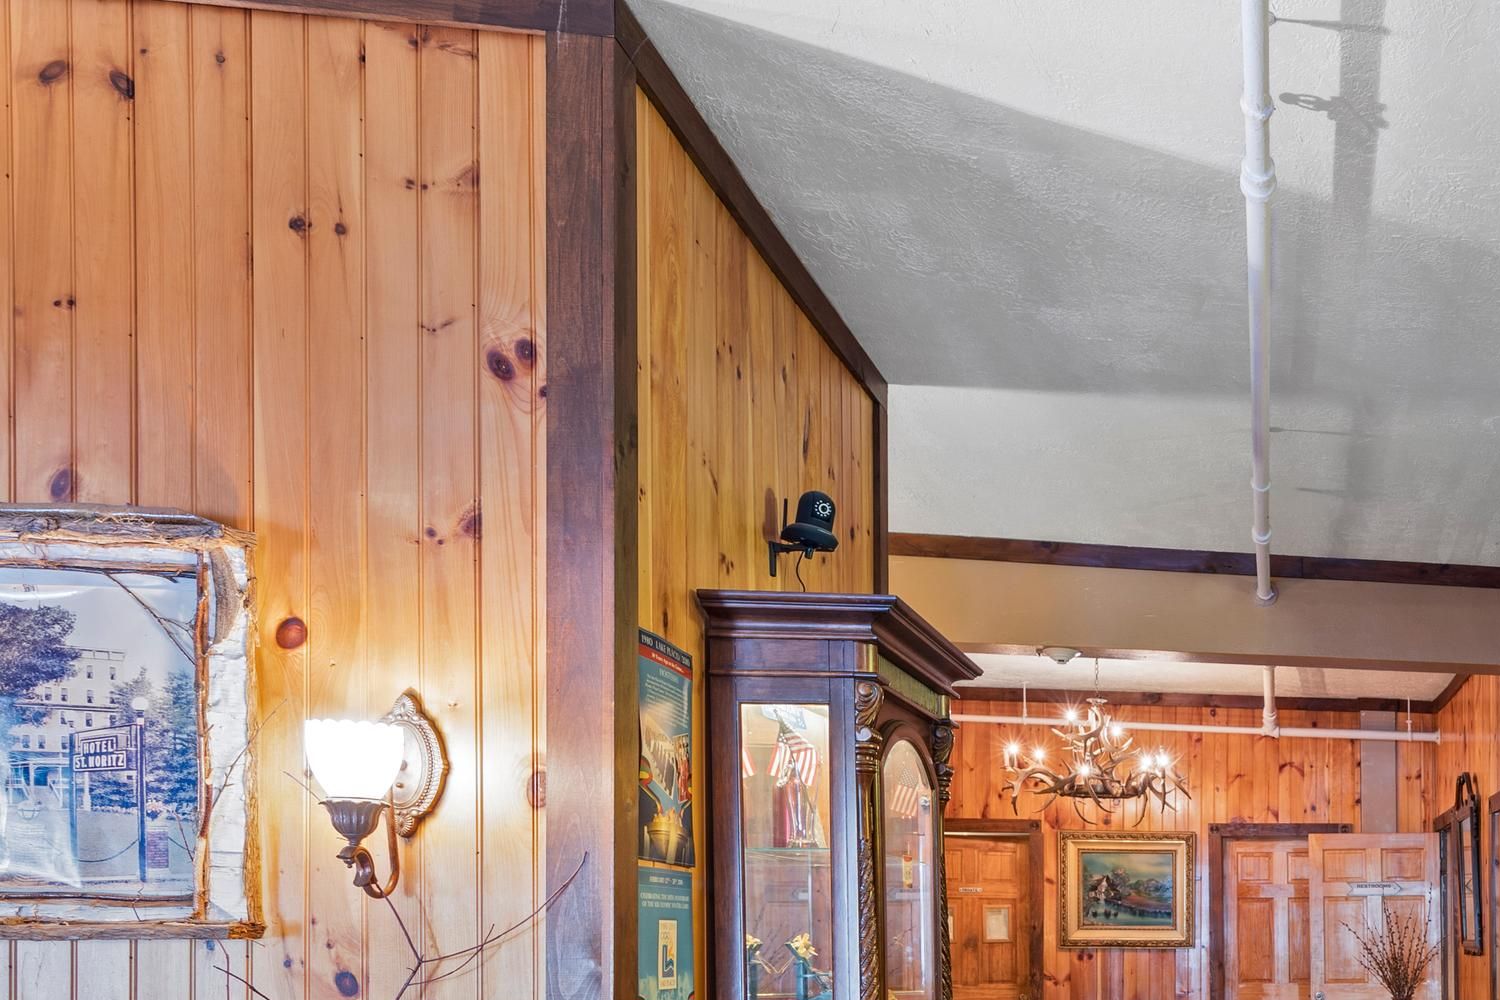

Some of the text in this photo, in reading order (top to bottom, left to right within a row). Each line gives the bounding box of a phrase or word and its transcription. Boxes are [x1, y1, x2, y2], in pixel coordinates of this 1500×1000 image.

[83, 740, 114, 754] HOTEL
[75, 754, 124, 769] ST. MORITZ
